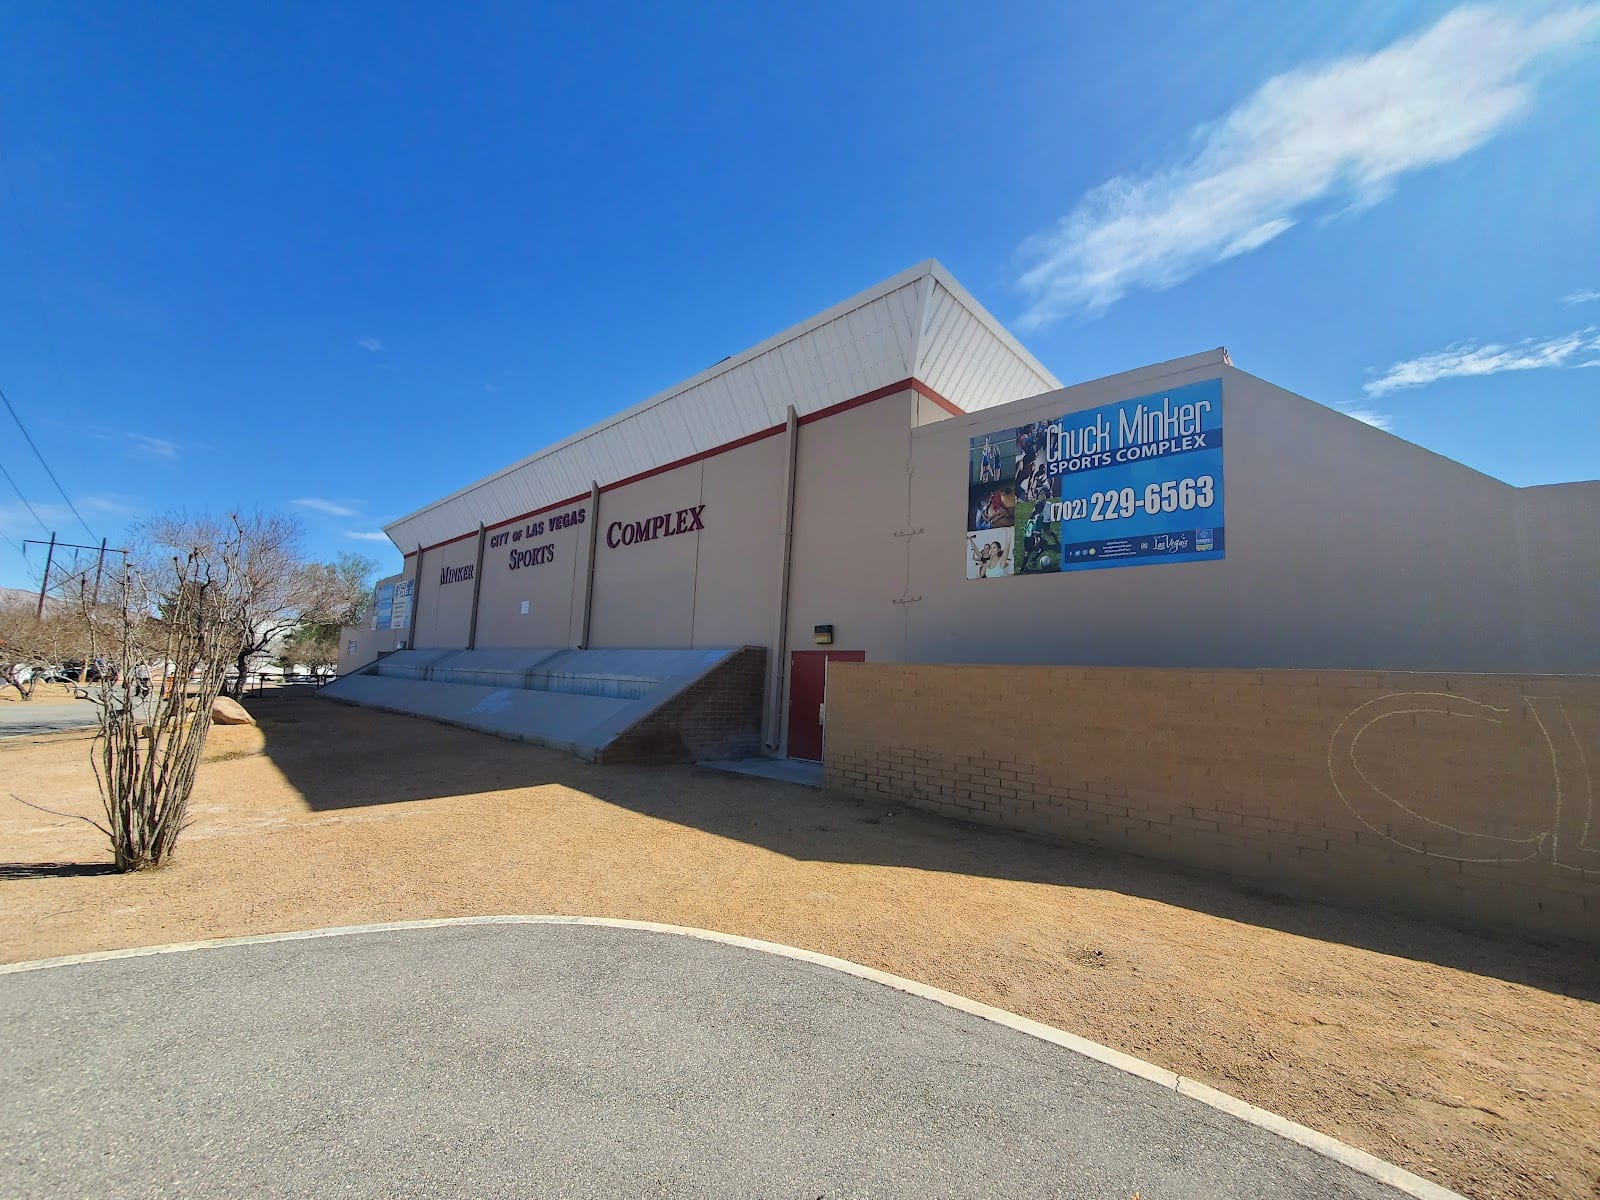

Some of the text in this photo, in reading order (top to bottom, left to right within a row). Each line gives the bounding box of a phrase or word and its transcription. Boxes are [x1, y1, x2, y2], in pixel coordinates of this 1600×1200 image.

[1046, 398, 1211, 463] Chuck Minker
[1049, 433, 1207, 476] SPORTS COMPLEX
[1050, 476, 1214, 523] (702) 229-6563
[491, 509, 586, 548] CITY OF LAS VEGAS
[606, 504, 706, 549] COMPLEX
[440, 564, 474, 585] MINKER
[508, 544, 554, 570] SPORTS
